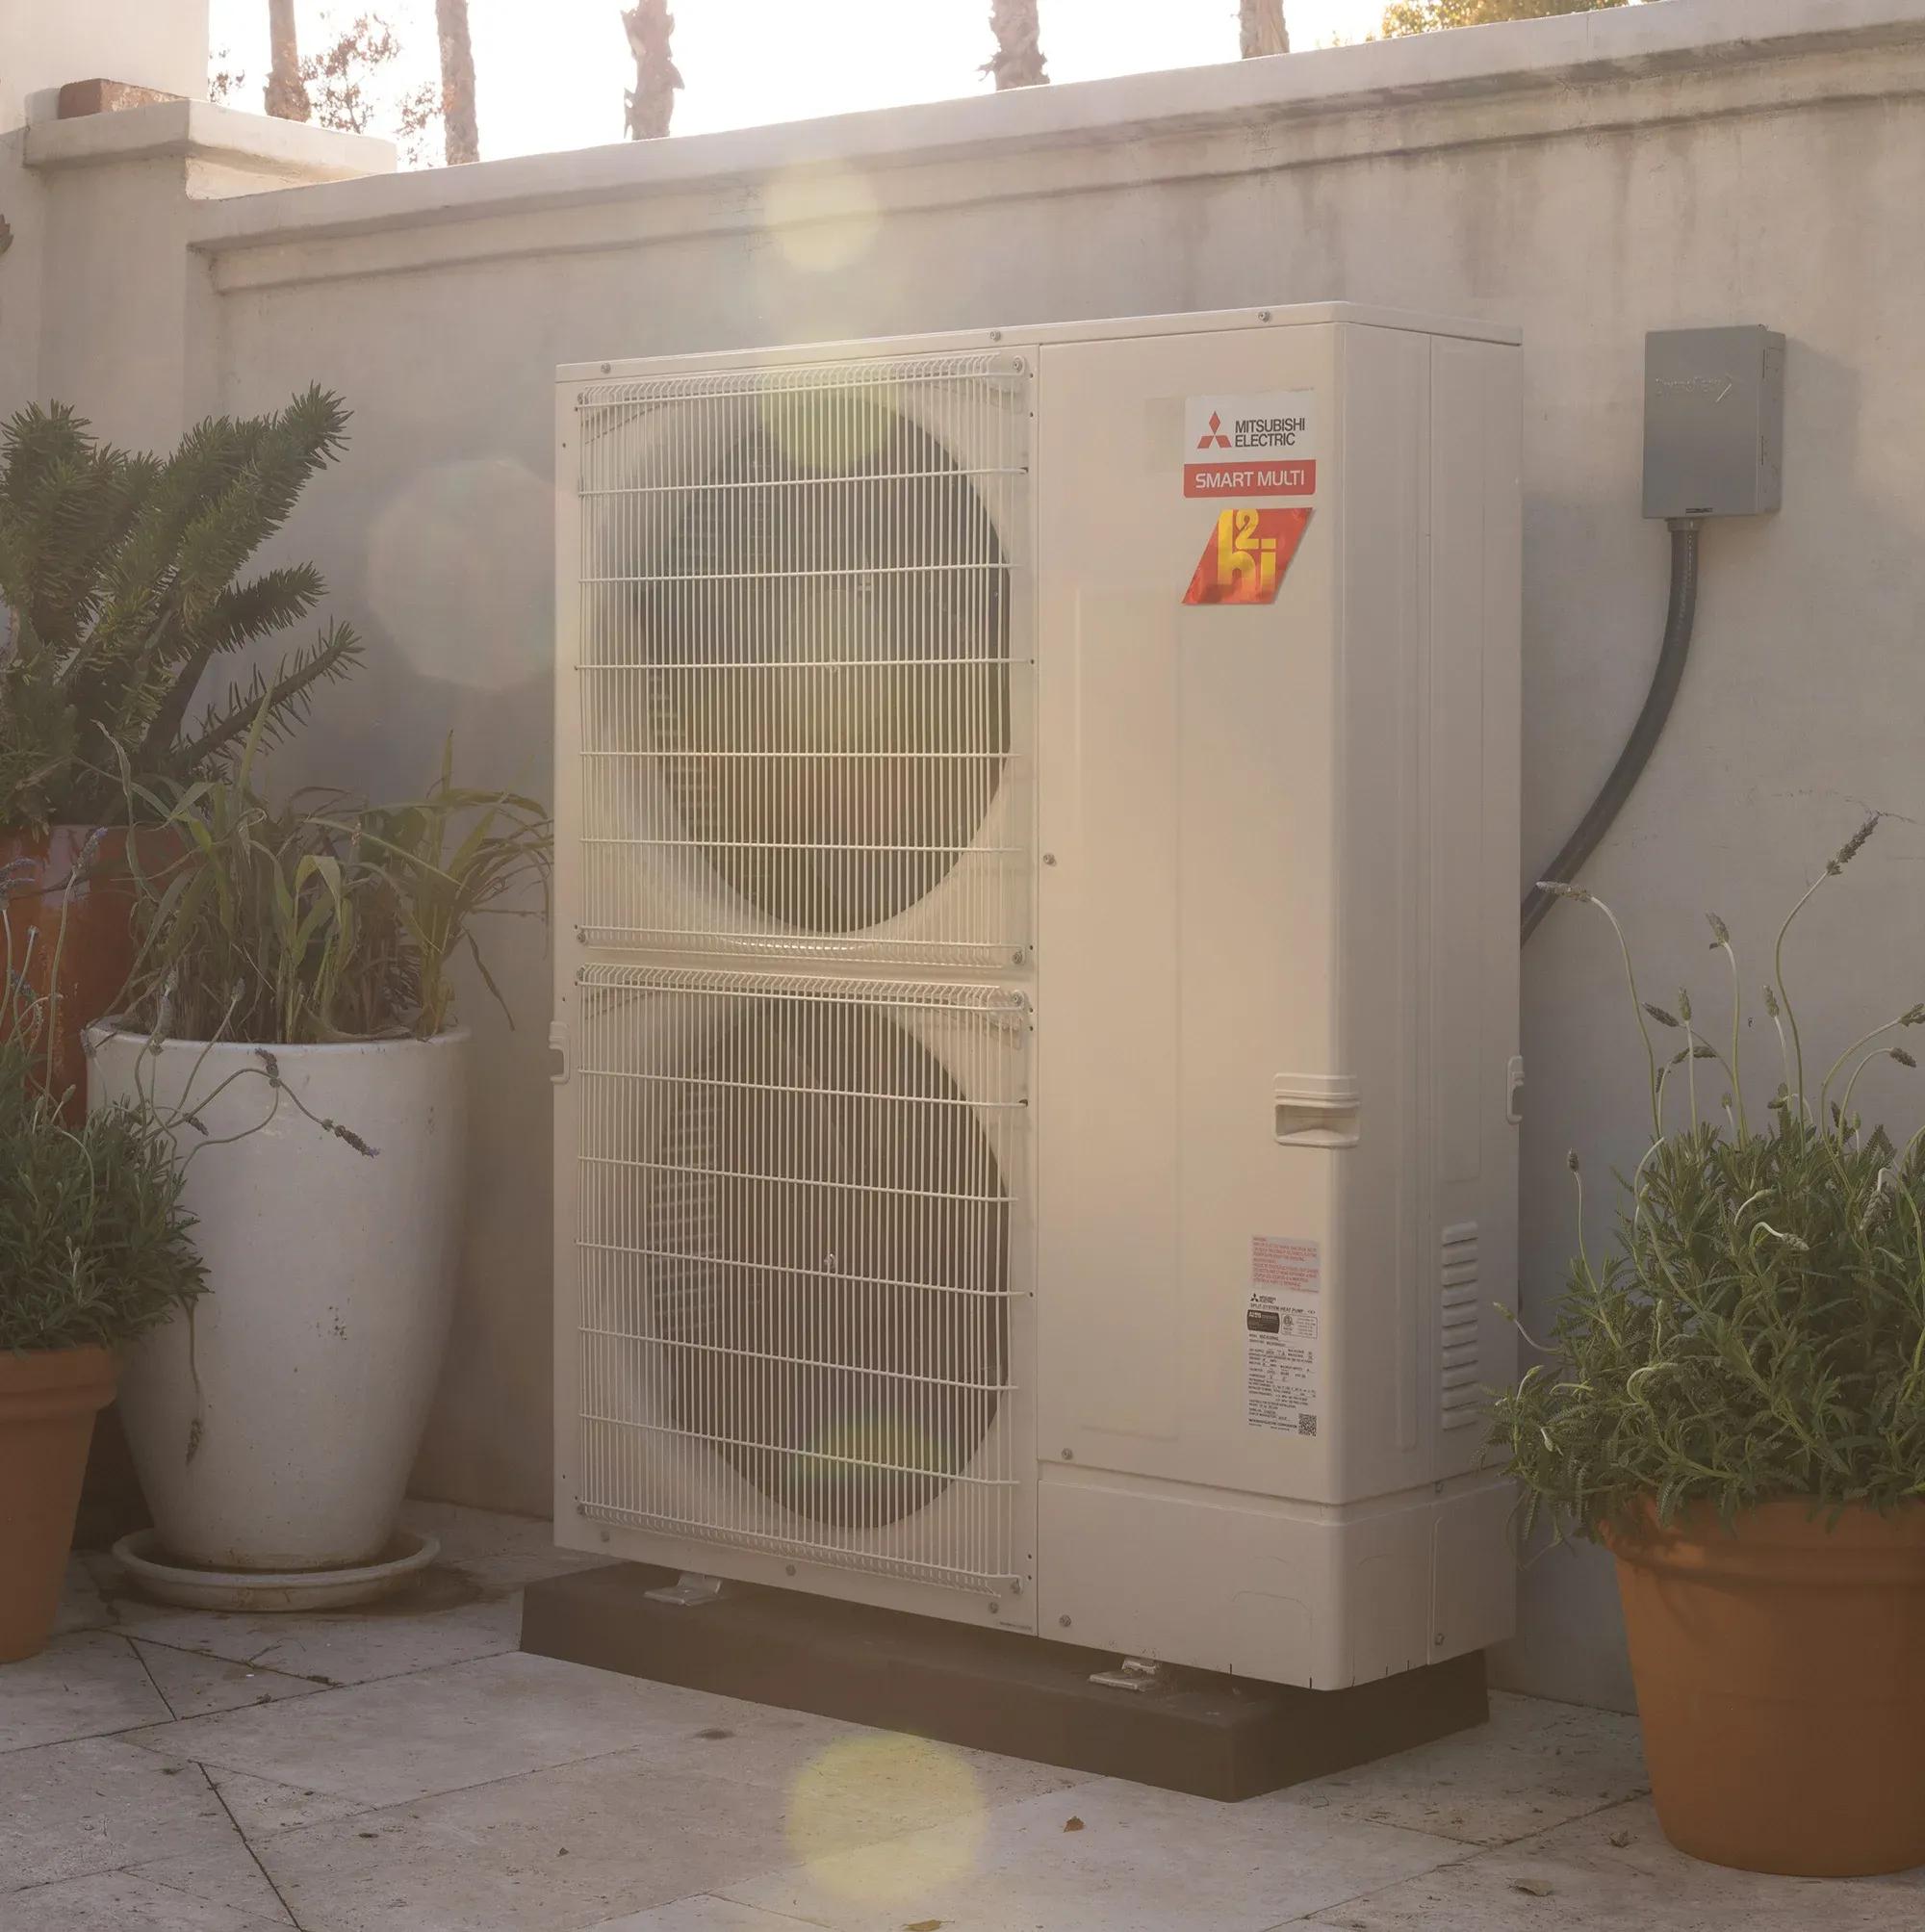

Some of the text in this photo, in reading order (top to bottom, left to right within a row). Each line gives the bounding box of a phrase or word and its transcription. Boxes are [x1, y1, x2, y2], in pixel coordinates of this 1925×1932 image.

[1235, 418, 1305, 433] MITSUBISHI
[1235, 433, 1296, 448] ELECTRIC
[1195, 470, 1305, 489] SMART MULTI
